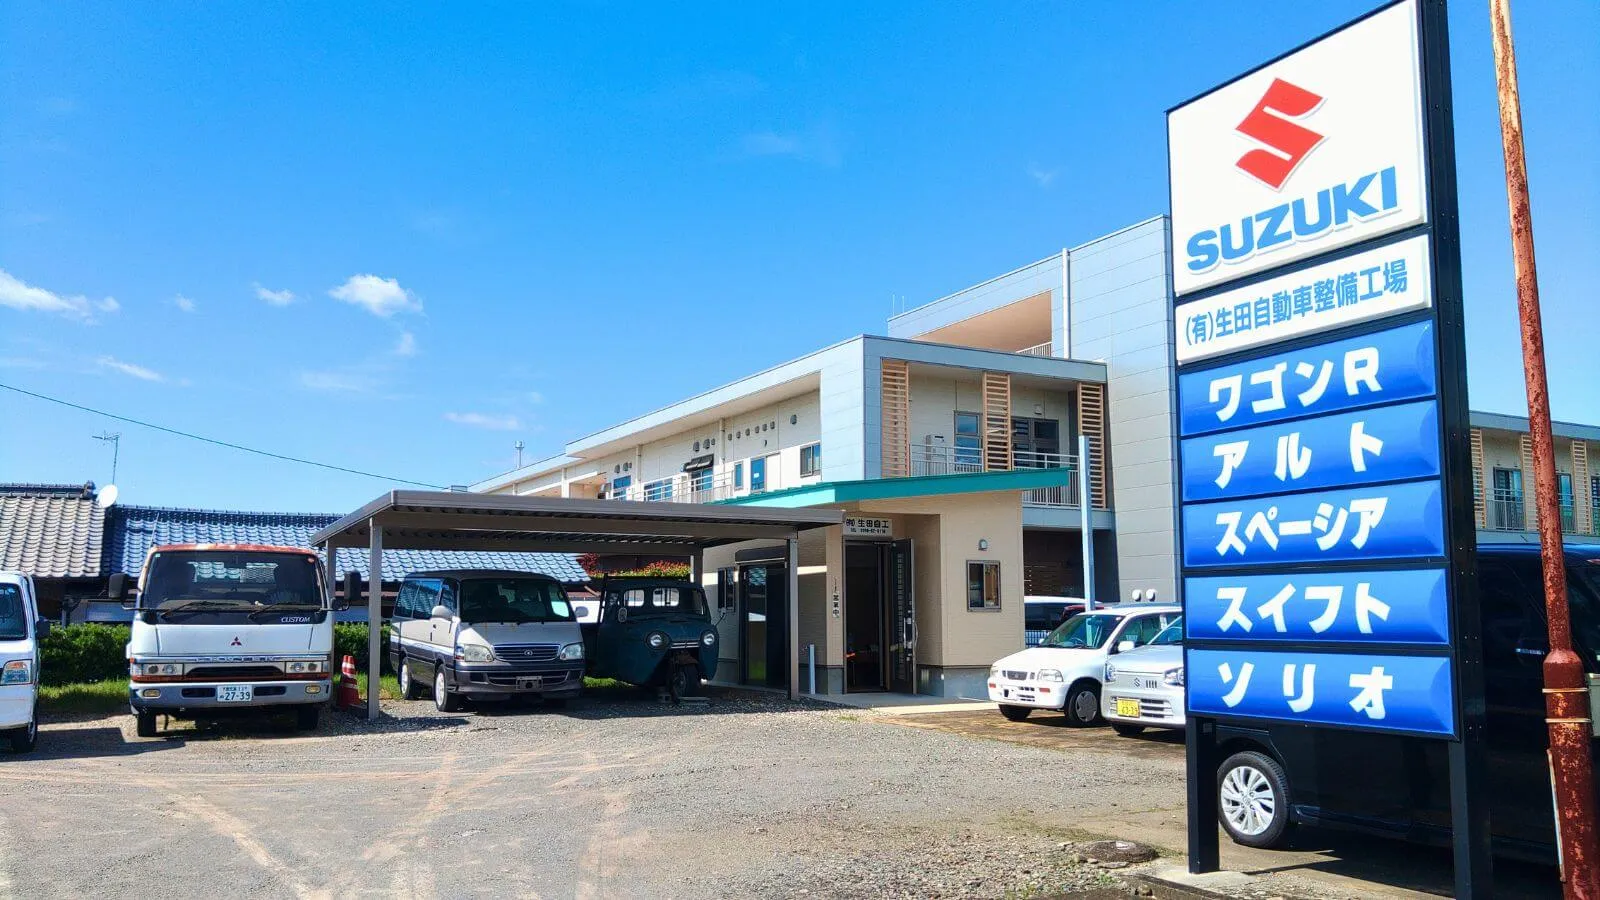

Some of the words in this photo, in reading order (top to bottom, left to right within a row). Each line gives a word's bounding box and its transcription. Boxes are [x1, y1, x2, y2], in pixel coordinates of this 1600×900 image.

[1186, 166, 1397, 271] SUZUKI
[1186, 259, 1408, 345] (有)生田自動車整備工場
[1208, 346, 1383, 422] ワゴンR
[1213, 421, 1384, 489] アルト
[1215, 497, 1388, 556] スペーシア
[1216, 583, 1391, 634] スイフト
[224, 691, 251, 701] 27-39
[1217, 661, 1394, 720] ソリオ
